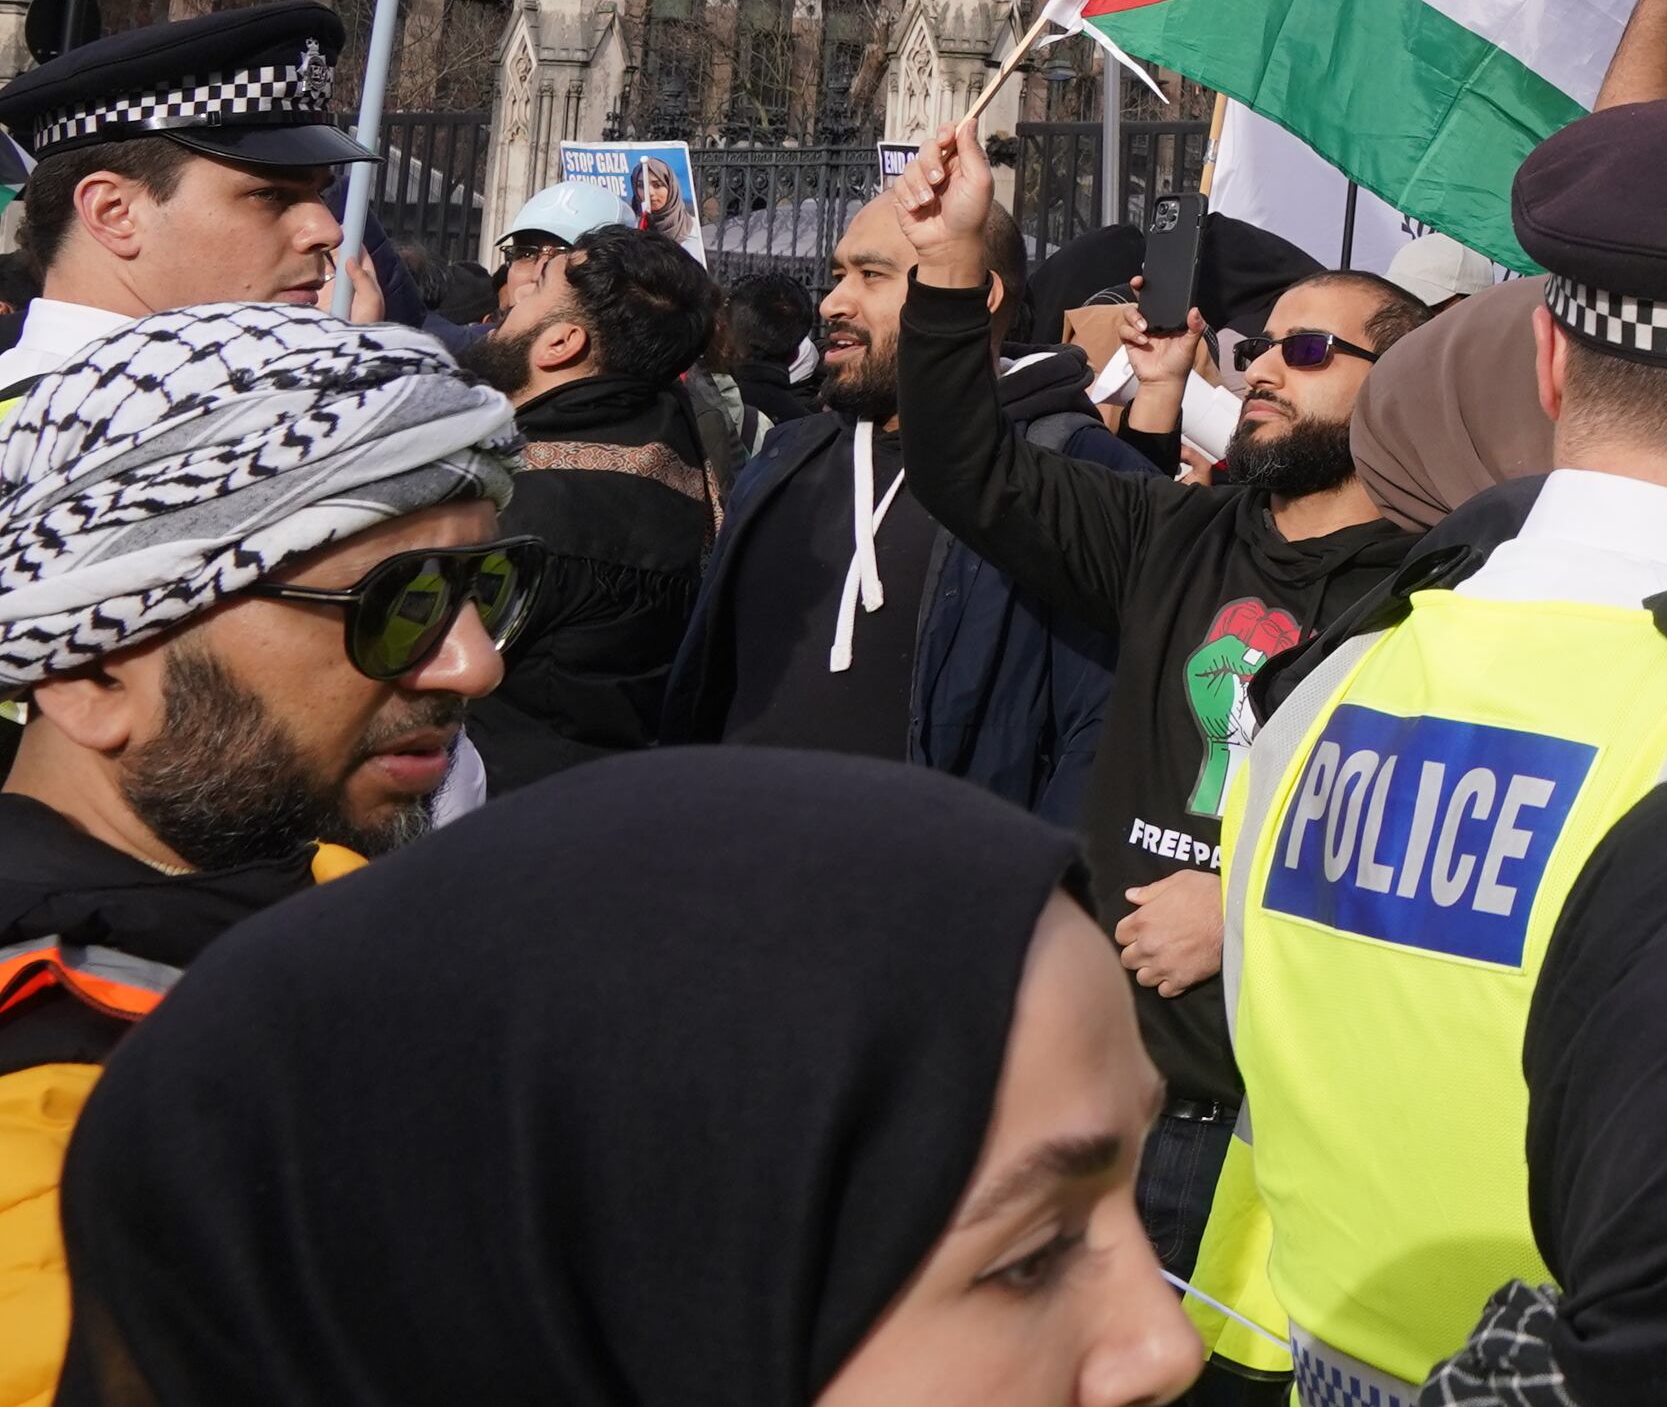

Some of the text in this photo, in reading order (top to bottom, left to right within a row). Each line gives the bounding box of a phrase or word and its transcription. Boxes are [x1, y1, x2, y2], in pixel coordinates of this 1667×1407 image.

[565, 151, 630, 174] STOP GAZA
[568, 174, 628, 197] OCIDE
[1128, 817, 1194, 862] FREE
[1284, 740, 1555, 916] POLICE
